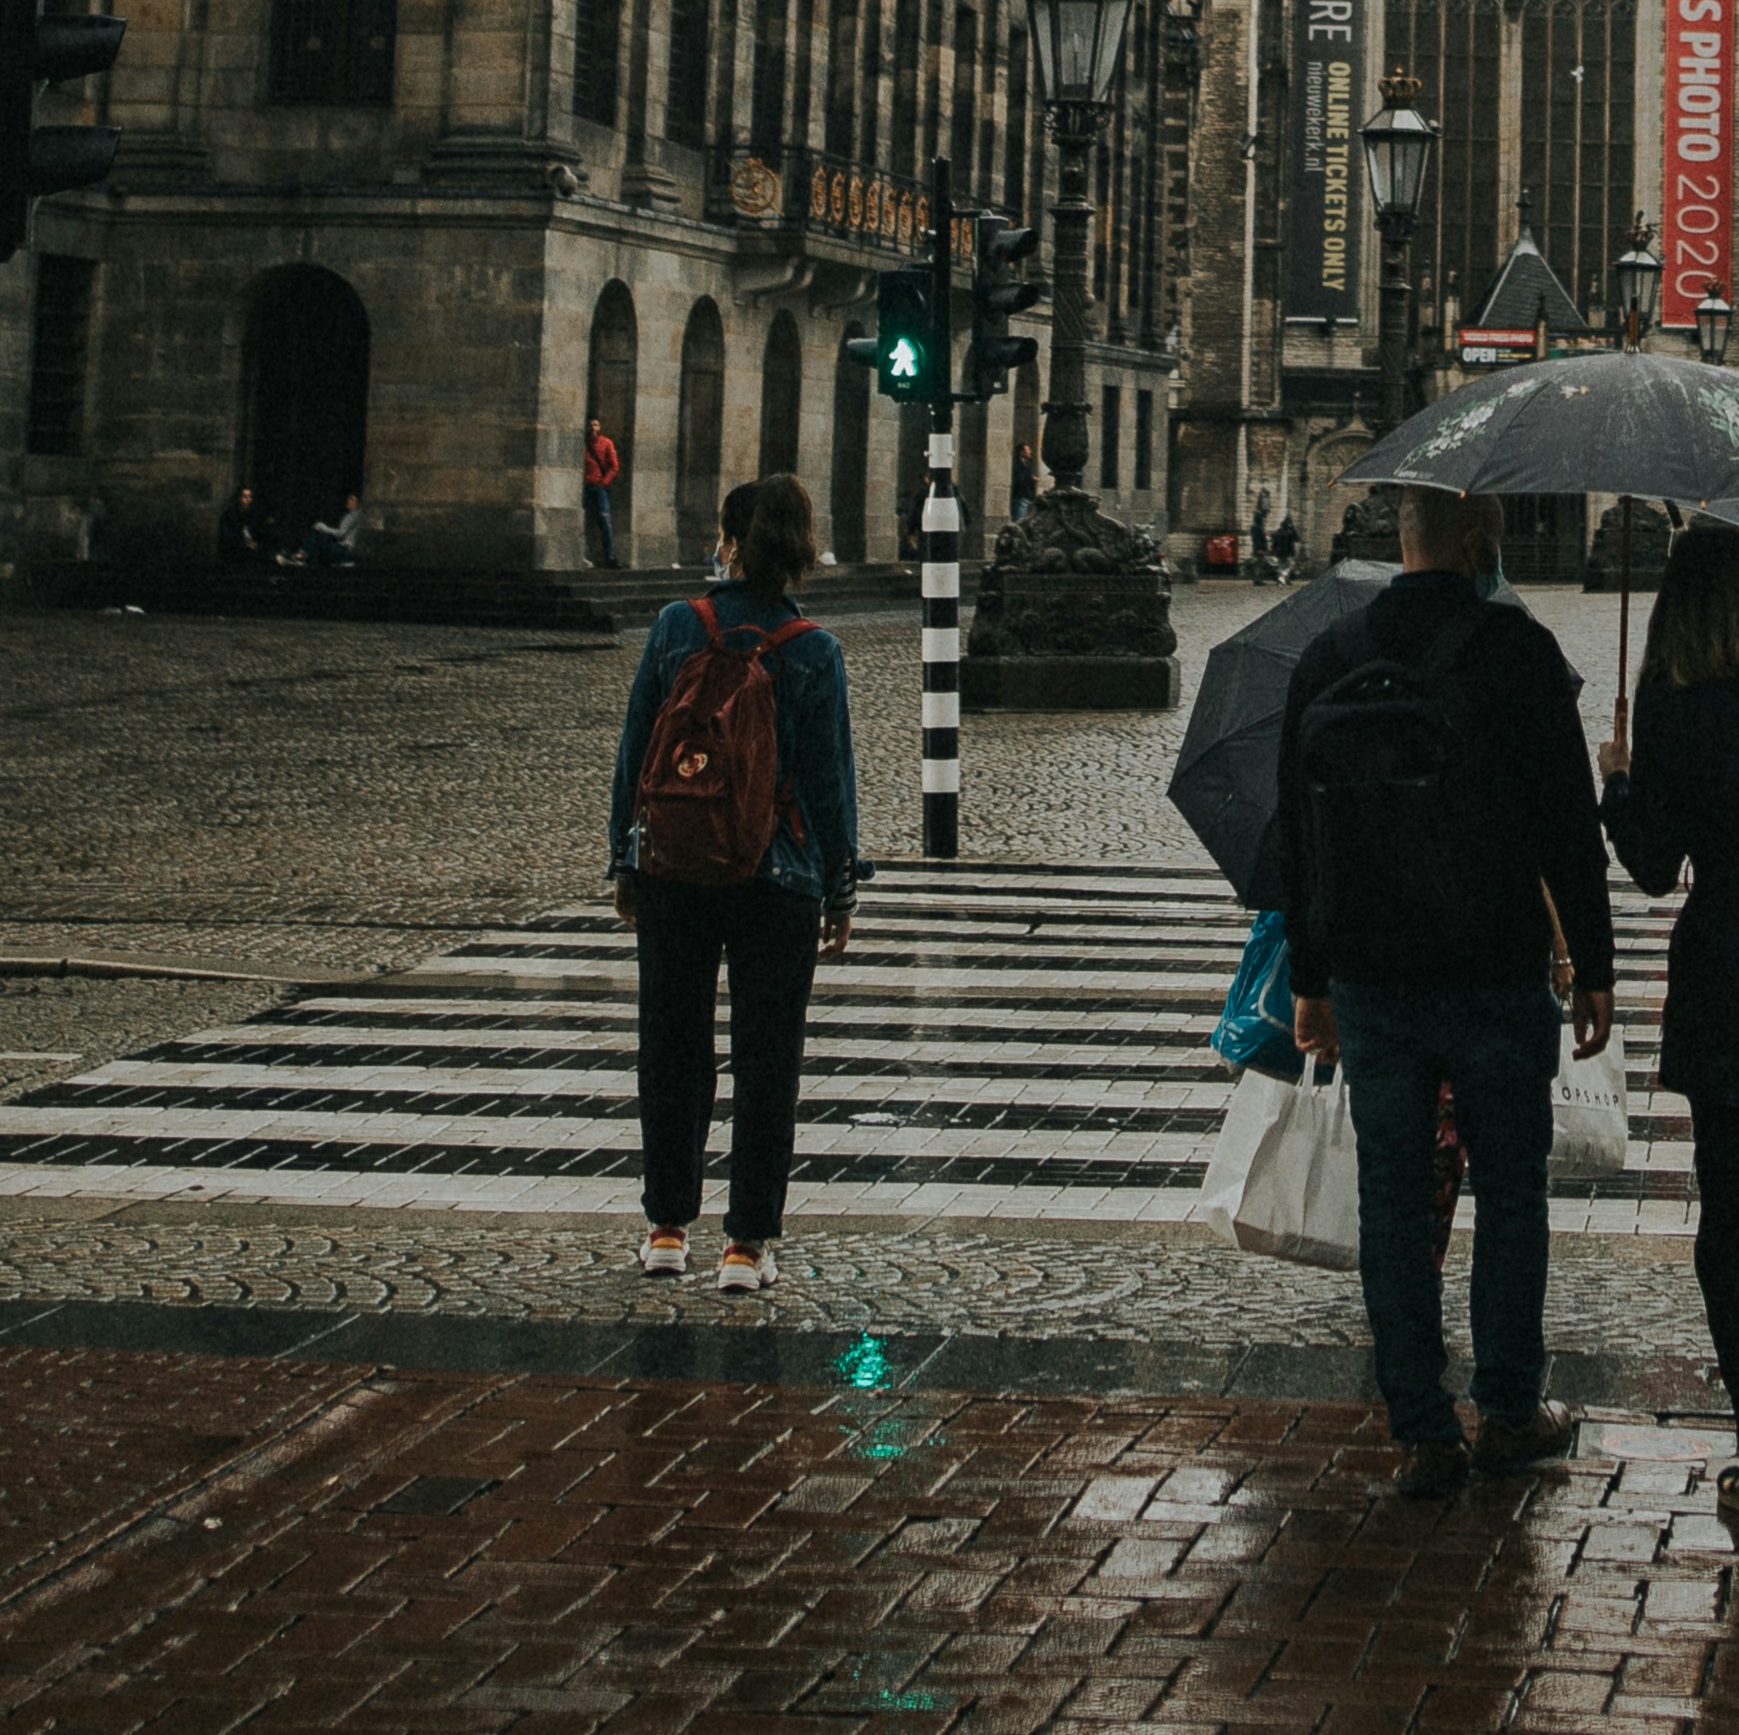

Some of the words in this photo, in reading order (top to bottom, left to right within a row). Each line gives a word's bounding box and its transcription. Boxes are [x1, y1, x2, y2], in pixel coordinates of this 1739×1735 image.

[1304, 62, 1326, 172] nieuwekerk.nl
[1326, 62, 1351, 140] ONLINE
[1677, 32, 1721, 162] PHOTO
[1323, 144, 1348, 232] TICKETS
[1322, 237, 1345, 291] ONLY
[1675, 174, 1720, 299] 2020
[1462, 347, 1497, 362] OPEN
